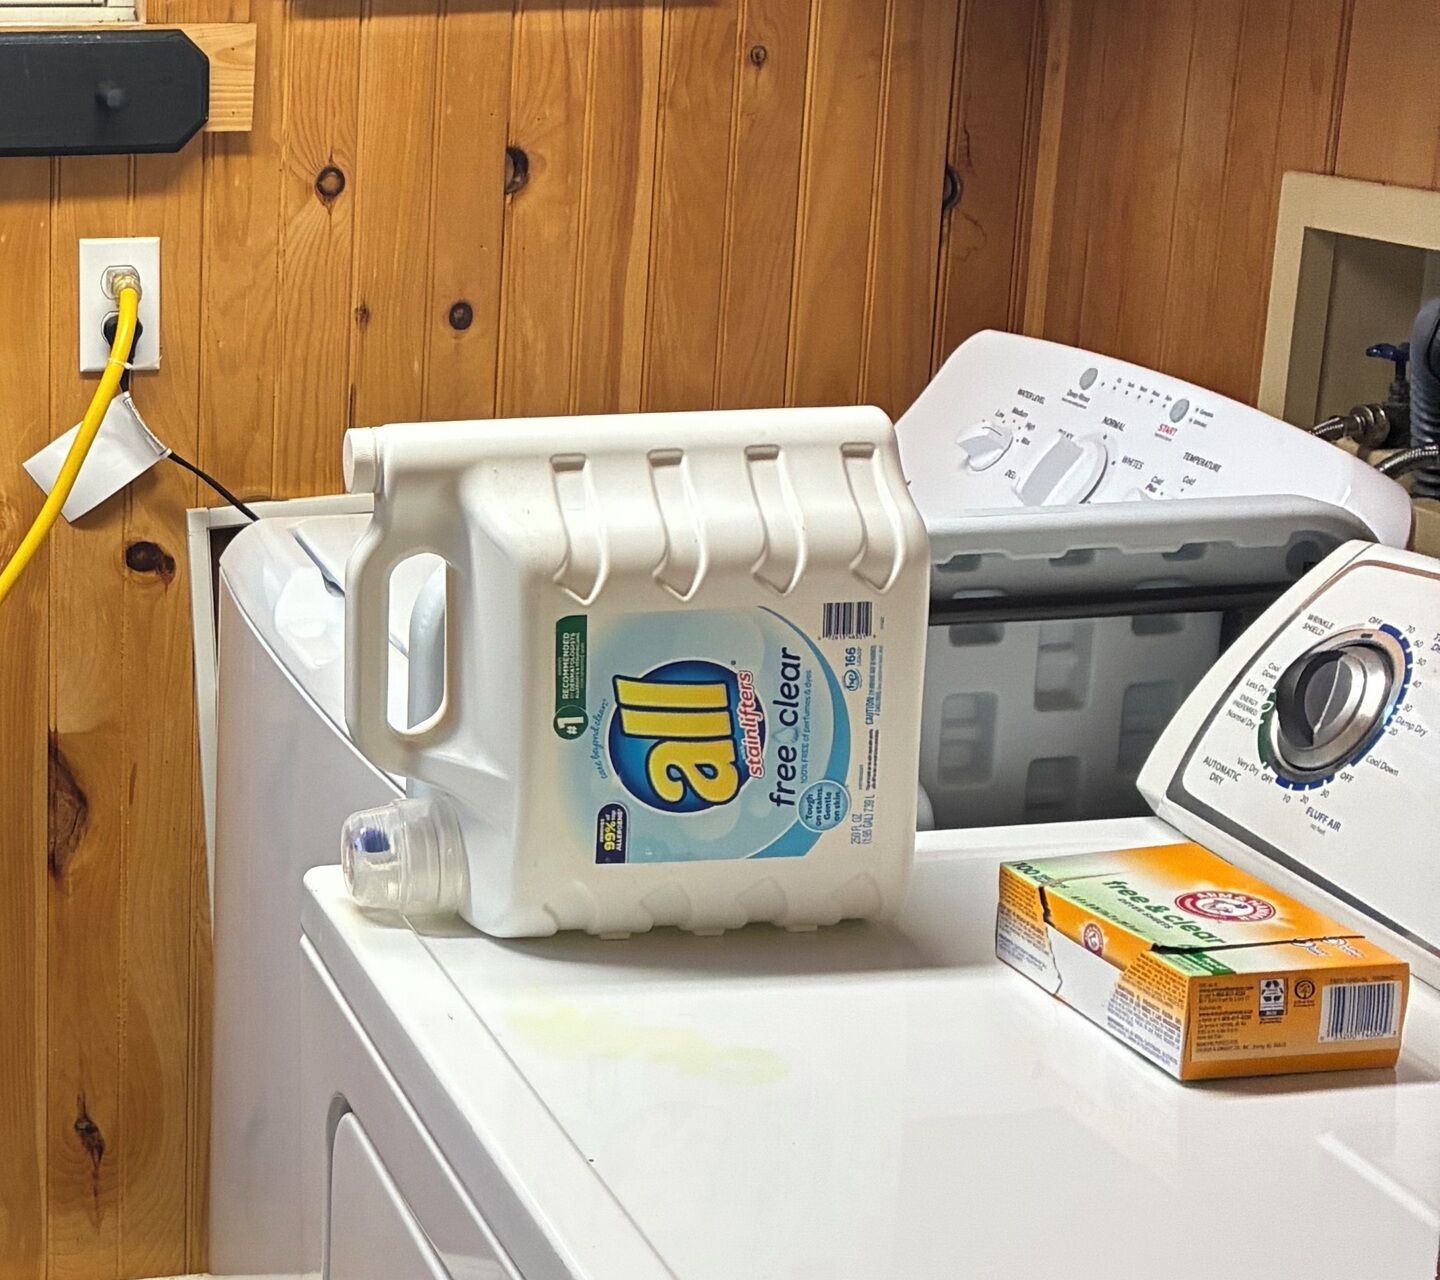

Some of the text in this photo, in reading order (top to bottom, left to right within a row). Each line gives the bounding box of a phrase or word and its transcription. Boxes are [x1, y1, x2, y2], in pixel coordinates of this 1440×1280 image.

[1158, 423, 1178, 436] START
[1183, 451, 1222, 473] TEMPERATURE
[1302, 622, 1325, 637] SHIELD
[1307, 613, 1335, 630] WRINKLE
[562, 632, 570, 700] RECOMMENDED
[845, 647, 856, 667] 166
[1257, 684, 1269, 697] Dry
[739, 670, 764, 779] stainlifters
[803, 696, 811, 733] perfumes
[1226, 709, 1256, 730] Normal Dry
[769, 647, 801, 807] free clear
[1416, 724, 1428, 737] Dry
[589, 727, 604, 760] beyond
[613, 675, 739, 803] all
[1203, 756, 1242, 782] AUTOMATIC
[1237, 757, 1260, 775] Very Dry
[1365, 755, 1399, 776] Cool Down
[1209, 772, 1224, 785] DRY
[1261, 773, 1274, 784] OFF
[1340, 772, 1354, 783] OFF
[806, 794, 815, 820] Tough
[824, 792, 832, 820] Gentle
[834, 811, 840, 821] on
[816, 815, 821, 826] on
[1306, 806, 1341, 832] FLUFF AIR
[604, 821, 617, 851] 99%
[1012, 862, 1040, 875] 100
[1196, 891, 1233, 899] ARM
[1102, 880, 1150, 904] free
[1145, 904, 1171, 913] &
[1162, 914, 1228, 943] clear
[1117, 898, 1146, 915] DRYER
[1142, 911, 1173, 929] SHEETS
